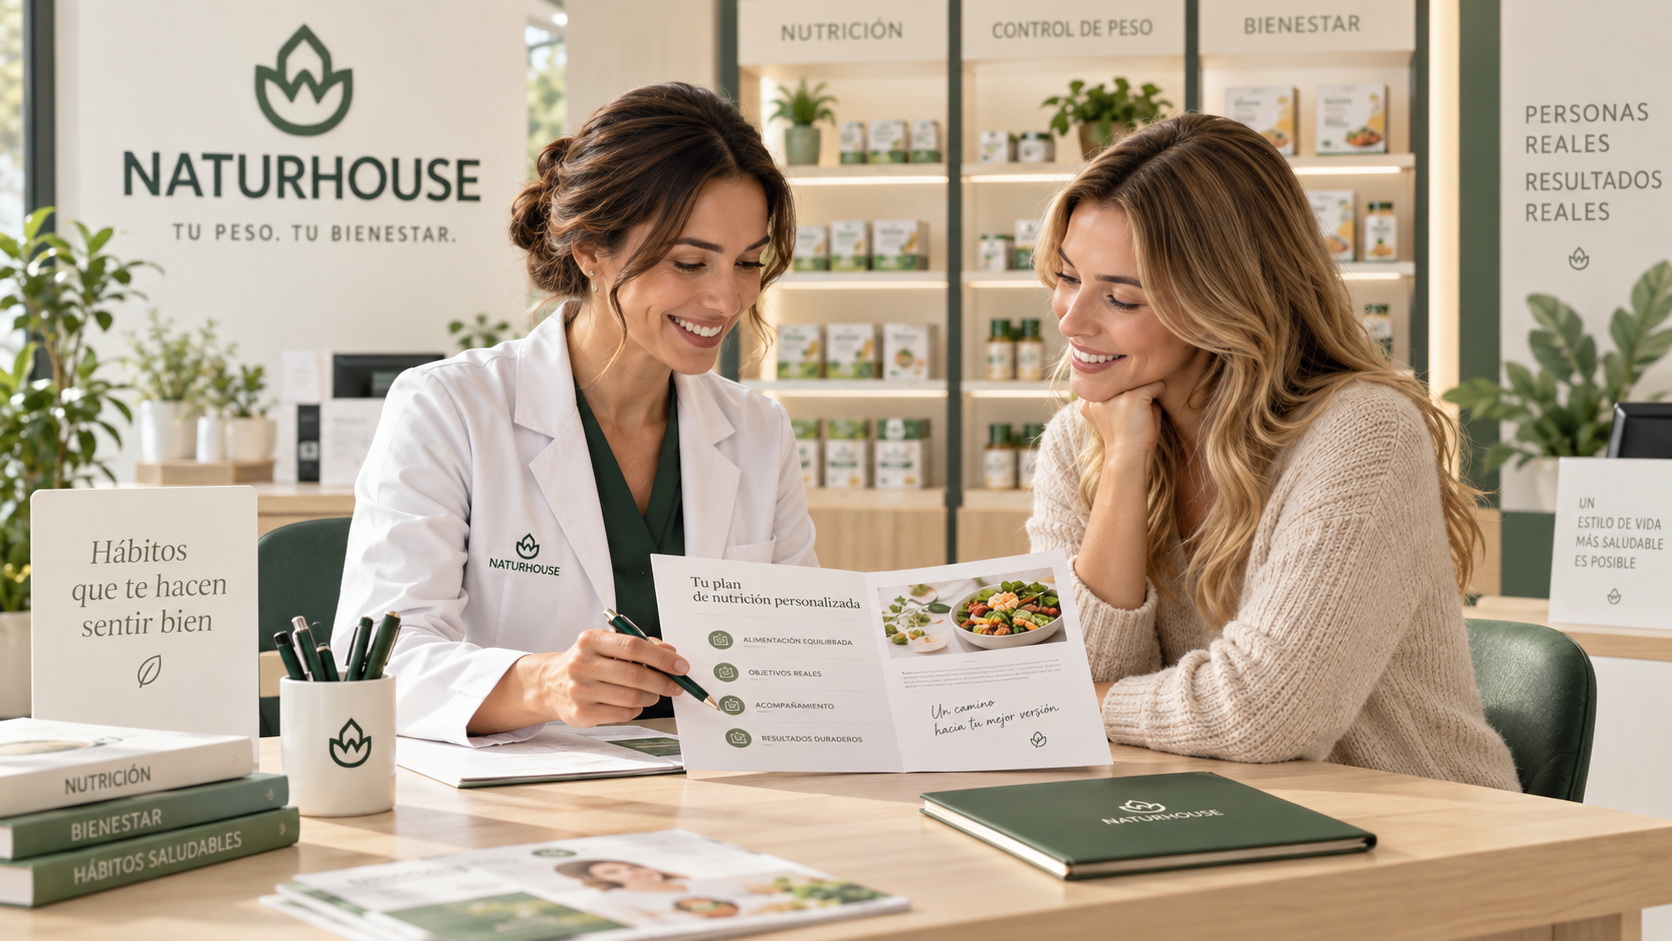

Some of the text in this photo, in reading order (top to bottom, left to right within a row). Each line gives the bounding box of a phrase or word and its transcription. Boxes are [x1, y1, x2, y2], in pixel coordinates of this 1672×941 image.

[781, 18, 903, 42] NUTRICIÓN
[992, 18, 1153, 40] CONTROL DE PESO
[1243, 14, 1362, 35] BIENESTAR
[1525, 102, 1649, 124] PERSONAS
[1525, 133, 1610, 154] REALES
[123, 151, 481, 202] NATURHOUSE
[1525, 170, 1662, 191] RESULTADOS
[1525, 202, 1610, 222] REALES
[172, 223, 457, 243] TU PESO. TU BIENESTAR.
[1578, 497, 1595, 509] UN
[1578, 516, 1662, 530] ESTILO DE VIDA
[90, 538, 187, 565] Hábitos
[1576, 533, 1664, 550] MÁS SALUDABLE
[489, 558, 560, 576] NATURHOUSE
[1574, 555, 1636, 569] ES POSIBLE
[71, 573, 227, 608] que te hacen
[690, 576, 742, 591] Tu plan
[693, 591, 861, 609] de nutrición personalizada
[81, 609, 212, 637] sentir bien
[743, 636, 801, 645] ALIMENTACIÓN
[748, 669, 822, 678] OBJETIVOS REALES
[755, 701, 834, 710] ACOMPAÑAMIENTO
[931, 700, 995, 720] Un camino
[934, 703, 1060, 737] hacia tu mejor versión
[762, 735, 812, 743] RESULTADOS
[65, 764, 152, 795] NUTRICIÓN
[71, 808, 163, 842] BIENESTAR
[1101, 809, 1224, 825] NATURHOUSE
[74, 831, 242, 885] HÁBITOS SALUDABLES
